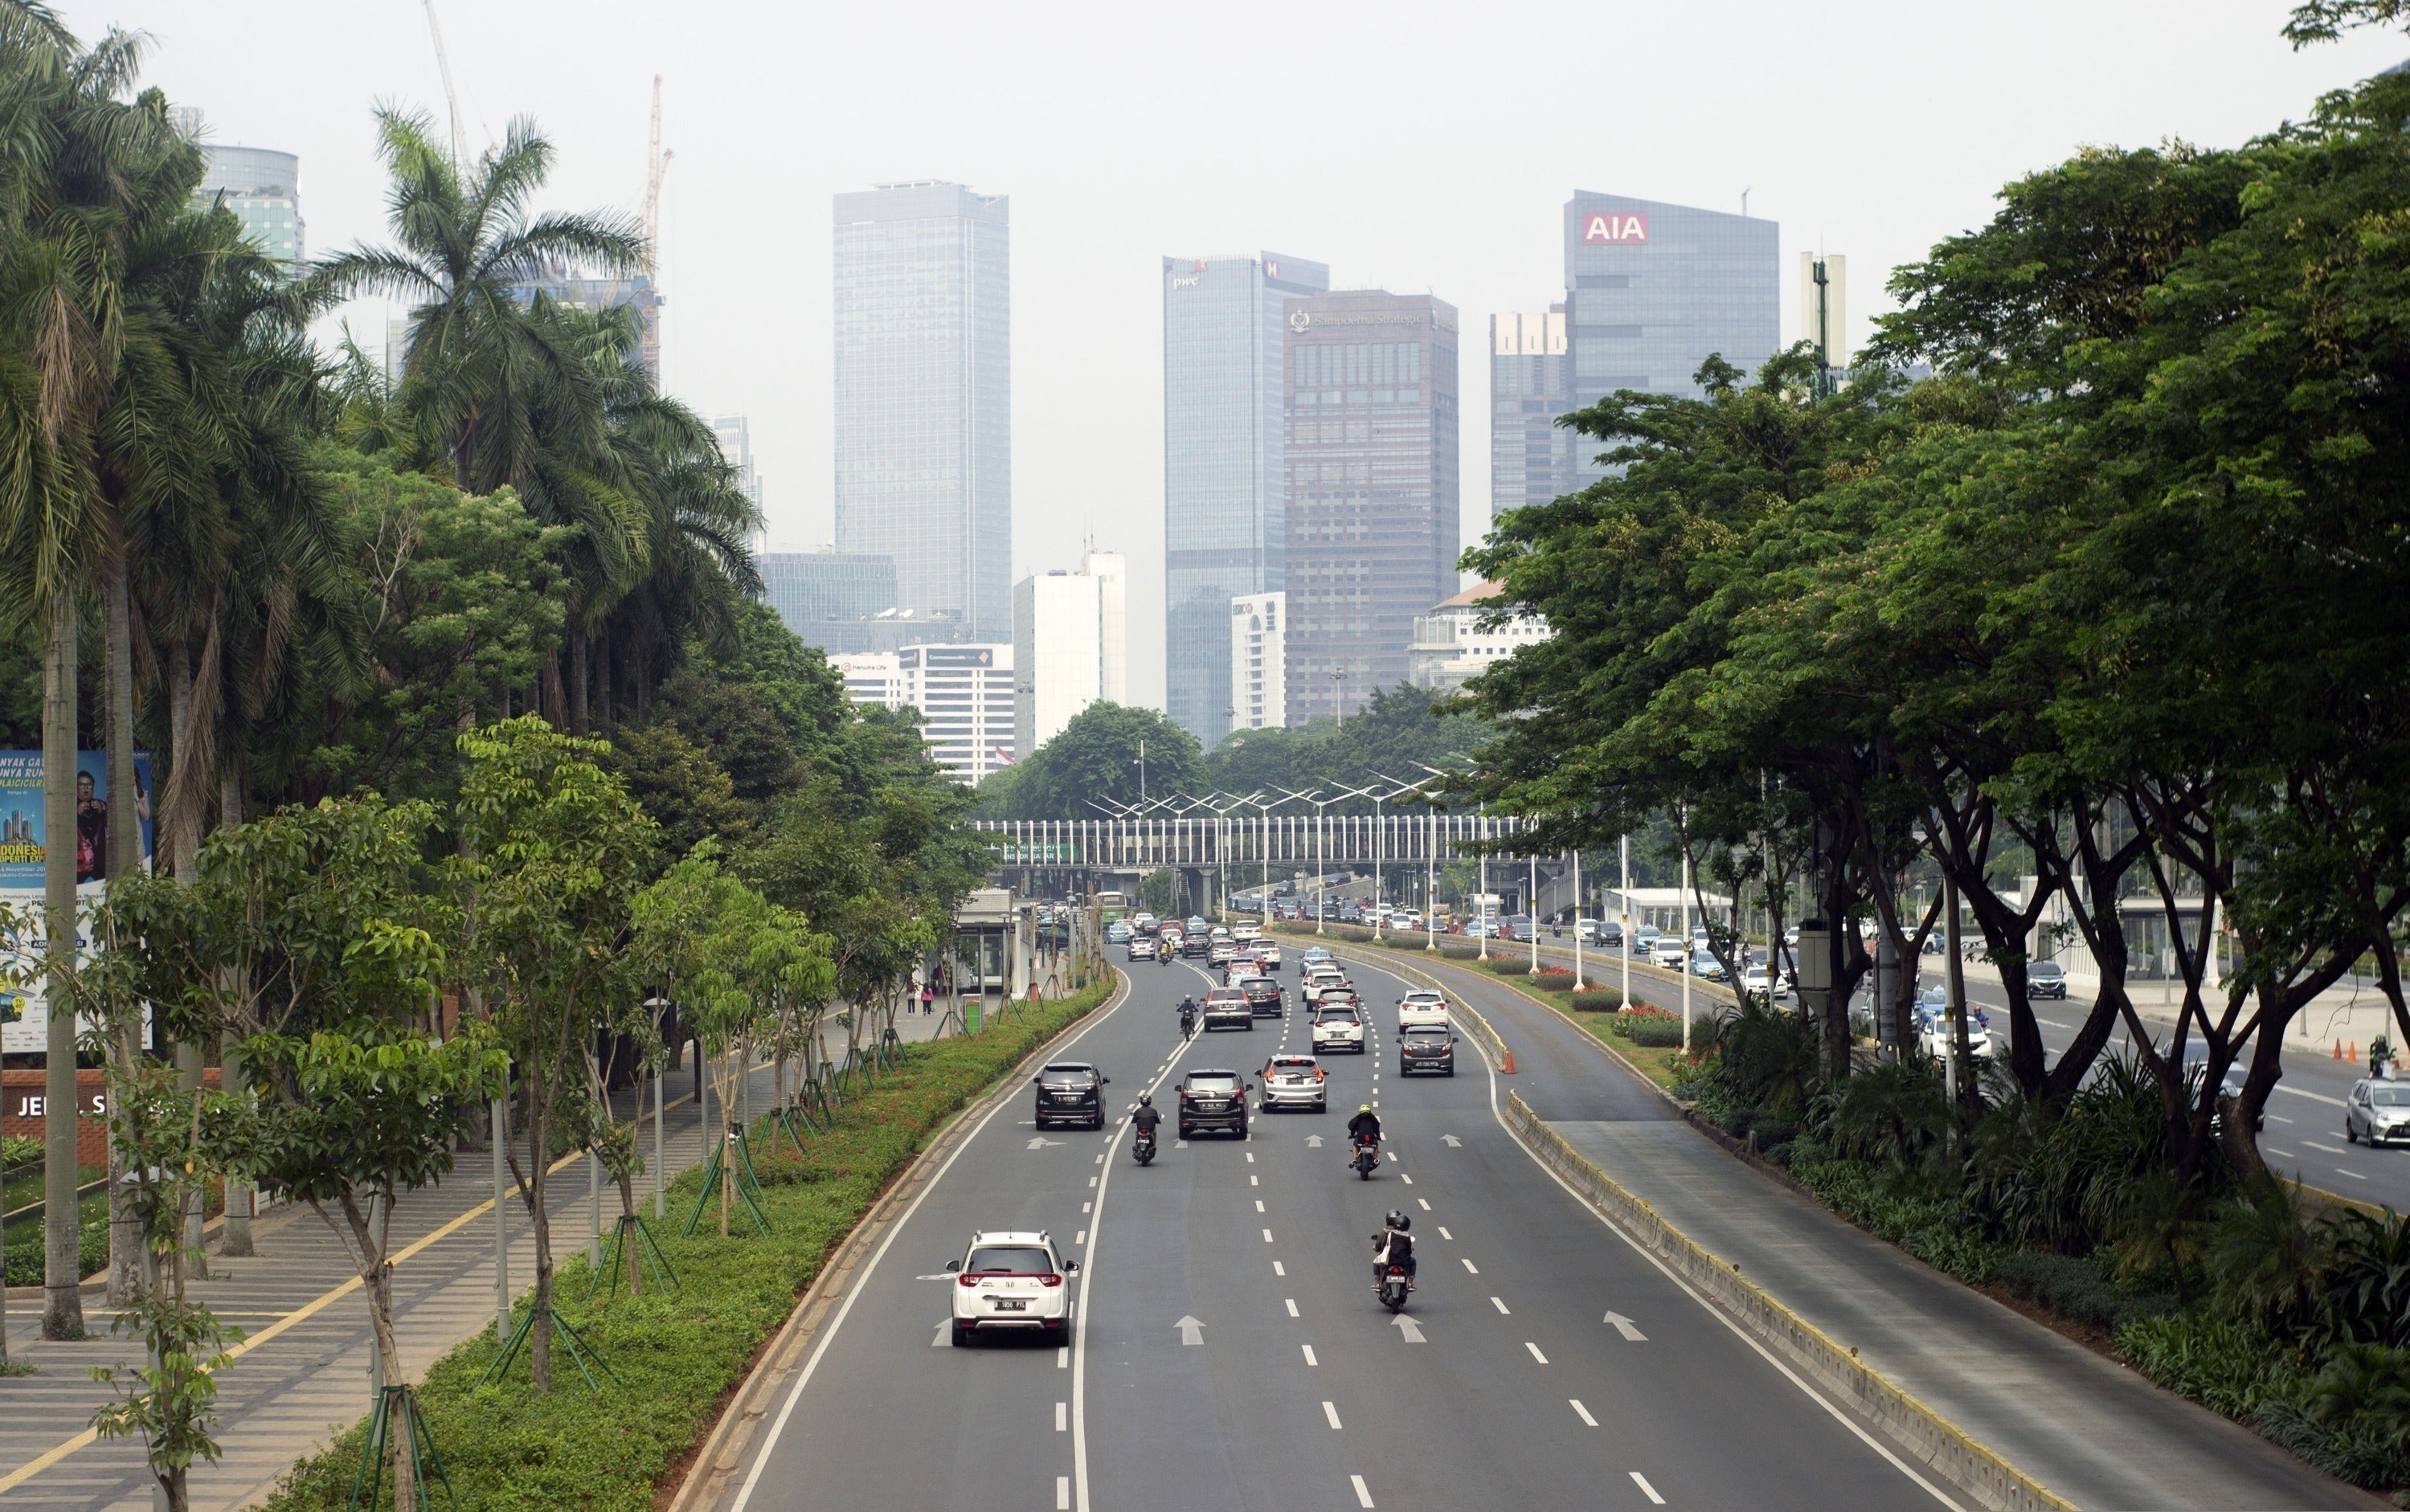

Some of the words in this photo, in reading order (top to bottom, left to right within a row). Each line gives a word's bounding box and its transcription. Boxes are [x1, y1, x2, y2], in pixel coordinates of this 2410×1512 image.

[1586, 216, 1645, 239] AIA
[1173, 276, 1198, 289] pwc
[1315, 315, 1374, 327] Sampoerna
[1377, 314, 1422, 325] Strategic
